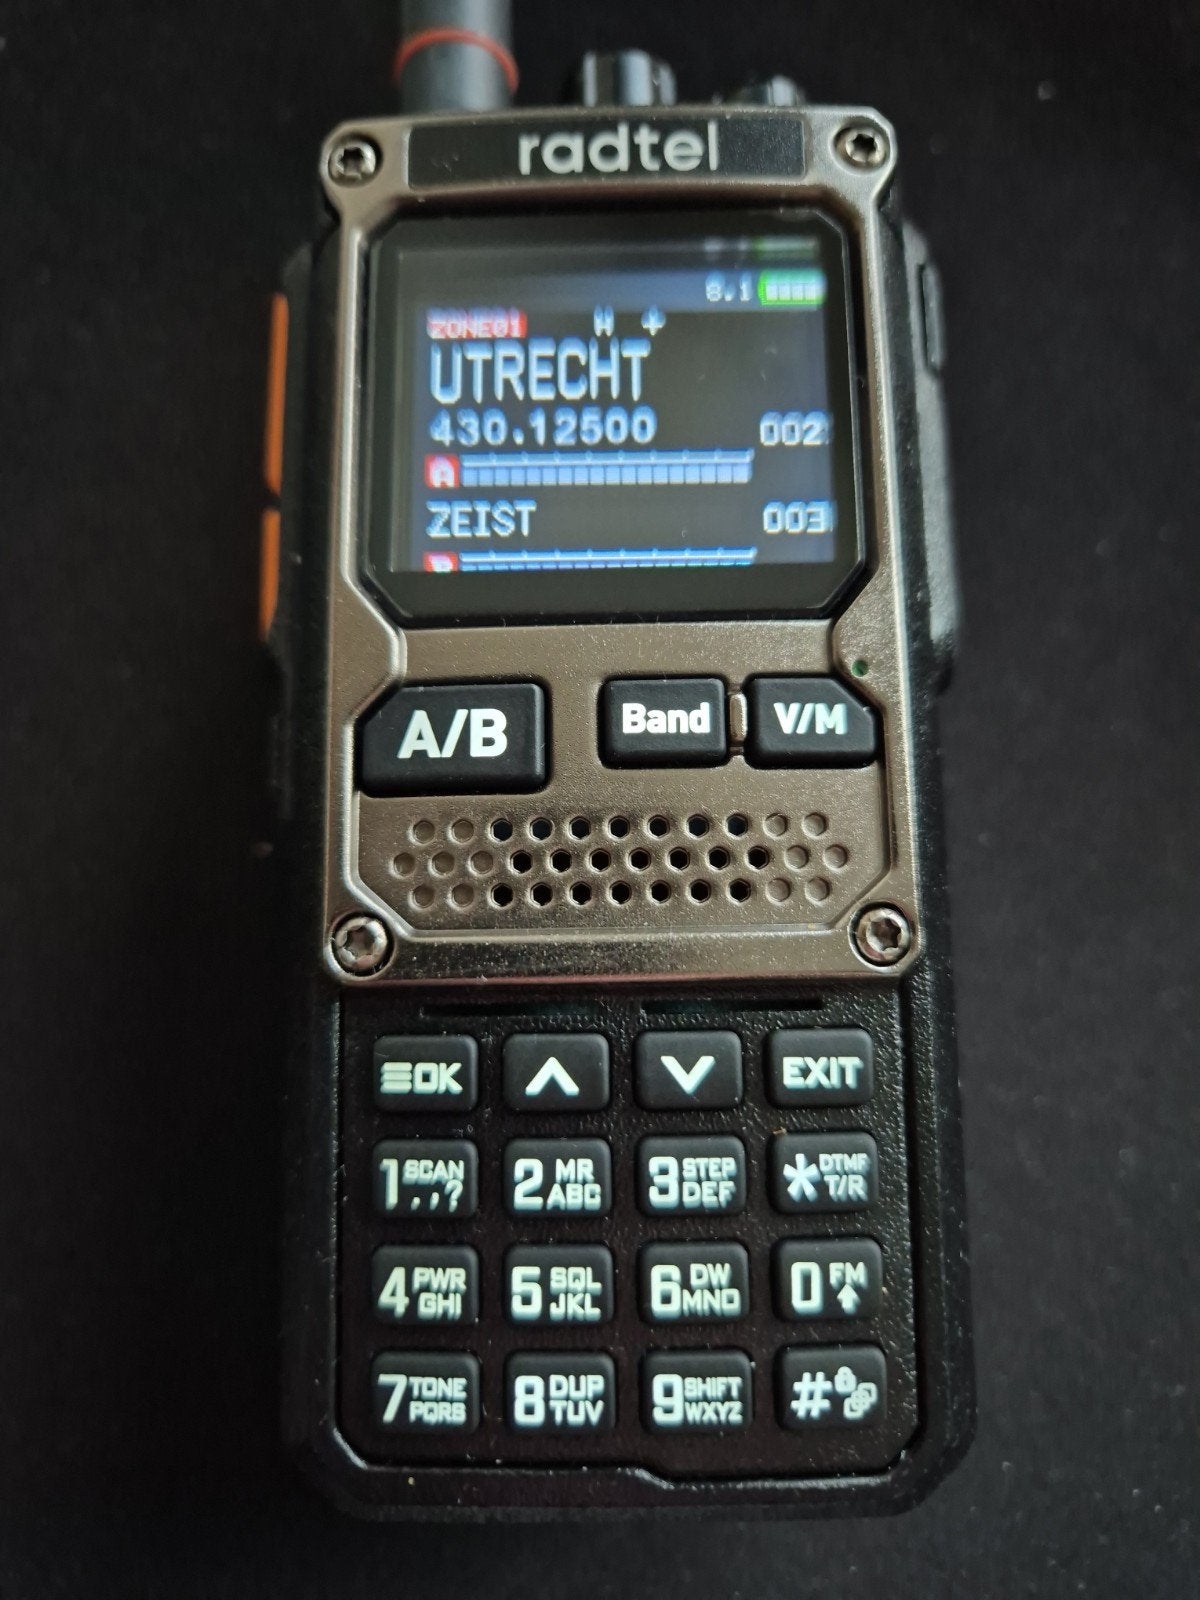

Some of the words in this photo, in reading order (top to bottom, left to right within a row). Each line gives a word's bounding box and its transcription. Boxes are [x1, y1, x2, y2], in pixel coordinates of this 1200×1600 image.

[518, 121, 720, 176] radtel
[430, 337, 651, 403] UTRECHT
[429, 405, 657, 447] 430.12500
[760, 411, 827, 447] 002
[426, 500, 537, 538] ZEIST
[763, 500, 833, 535] 003
[397, 708, 508, 760] A/B
[621, 702, 711, 735] Band
[774, 702, 848, 735] V/M
[412, 1062, 463, 1095] OK
[782, 1056, 864, 1090] EXIT
[649, 1156, 680, 1209] 3
[682, 1157, 738, 1181] STEP
[818, 1153, 871, 1176] DTMF
[380, 1158, 399, 1211] 1
[402, 1159, 464, 1185] SCAN
[513, 1158, 544, 1211] 2
[555, 1158, 595, 1184] MR
[546, 1183, 602, 1211] ABC
[682, 1181, 737, 1209] DEF
[823, 1174, 869, 1202] T/R
[377, 1266, 410, 1318] 4
[412, 1266, 468, 1294] PWR
[417, 1292, 463, 1320] GHI
[511, 1265, 543, 1321] 5
[549, 1266, 603, 1294] SQL
[650, 1264, 682, 1319] 6
[689, 1263, 732, 1289] DW
[681, 1288, 742, 1317] MNO
[790, 1261, 823, 1315] 0
[828, 1261, 868, 1290] FM
[549, 1293, 602, 1321] JKL
[377, 1373, 408, 1424] 7
[408, 1376, 468, 1401] TONE
[408, 1401, 467, 1426] PQRS
[514, 1375, 546, 1427] 8
[549, 1374, 605, 1401] DUP
[548, 1400, 604, 1427] TUV
[652, 1373, 684, 1427] 9
[683, 1376, 743, 1401] SHIFT
[684, 1400, 743, 1427] WXYZ
